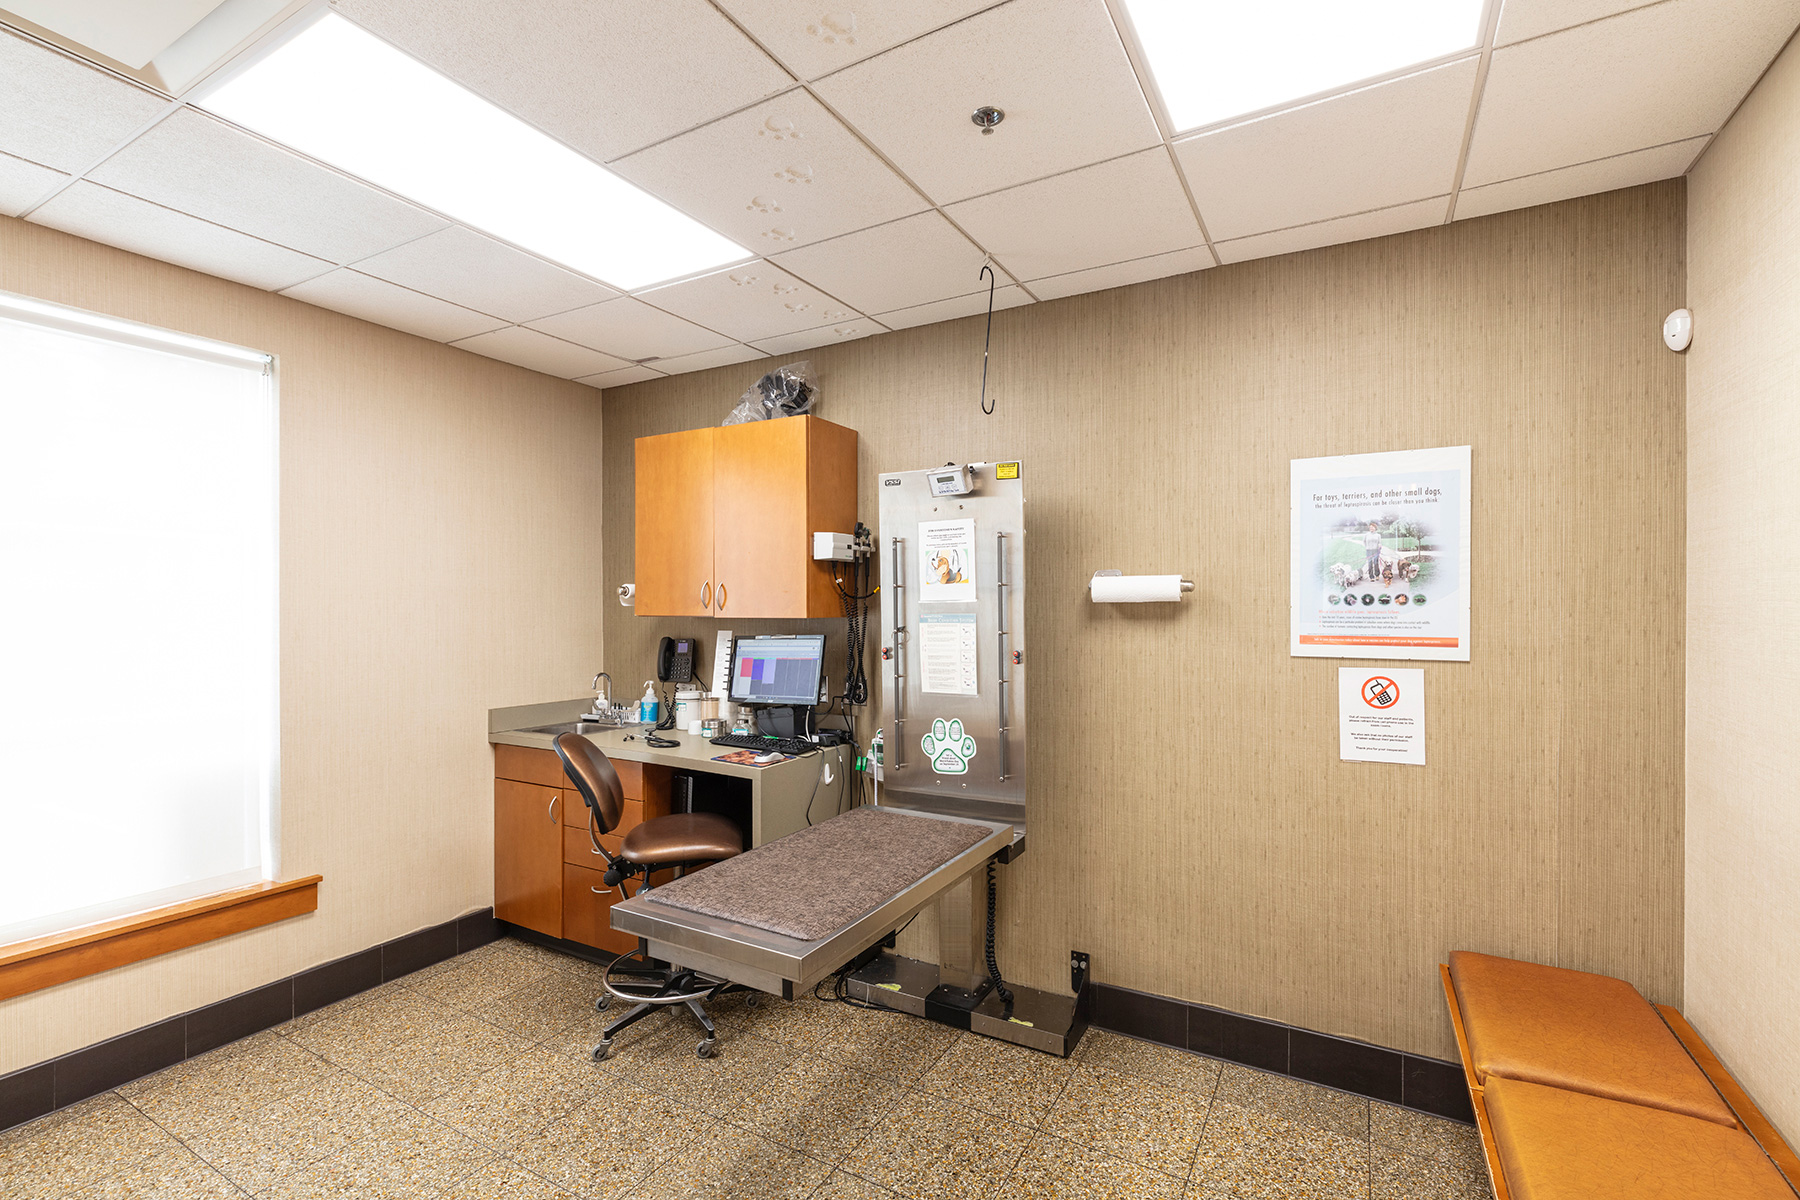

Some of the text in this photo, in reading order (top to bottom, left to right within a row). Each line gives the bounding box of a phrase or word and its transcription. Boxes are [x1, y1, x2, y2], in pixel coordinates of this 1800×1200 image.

[1313, 487, 1442, 502] For toys, terriers, and other small dogs,
